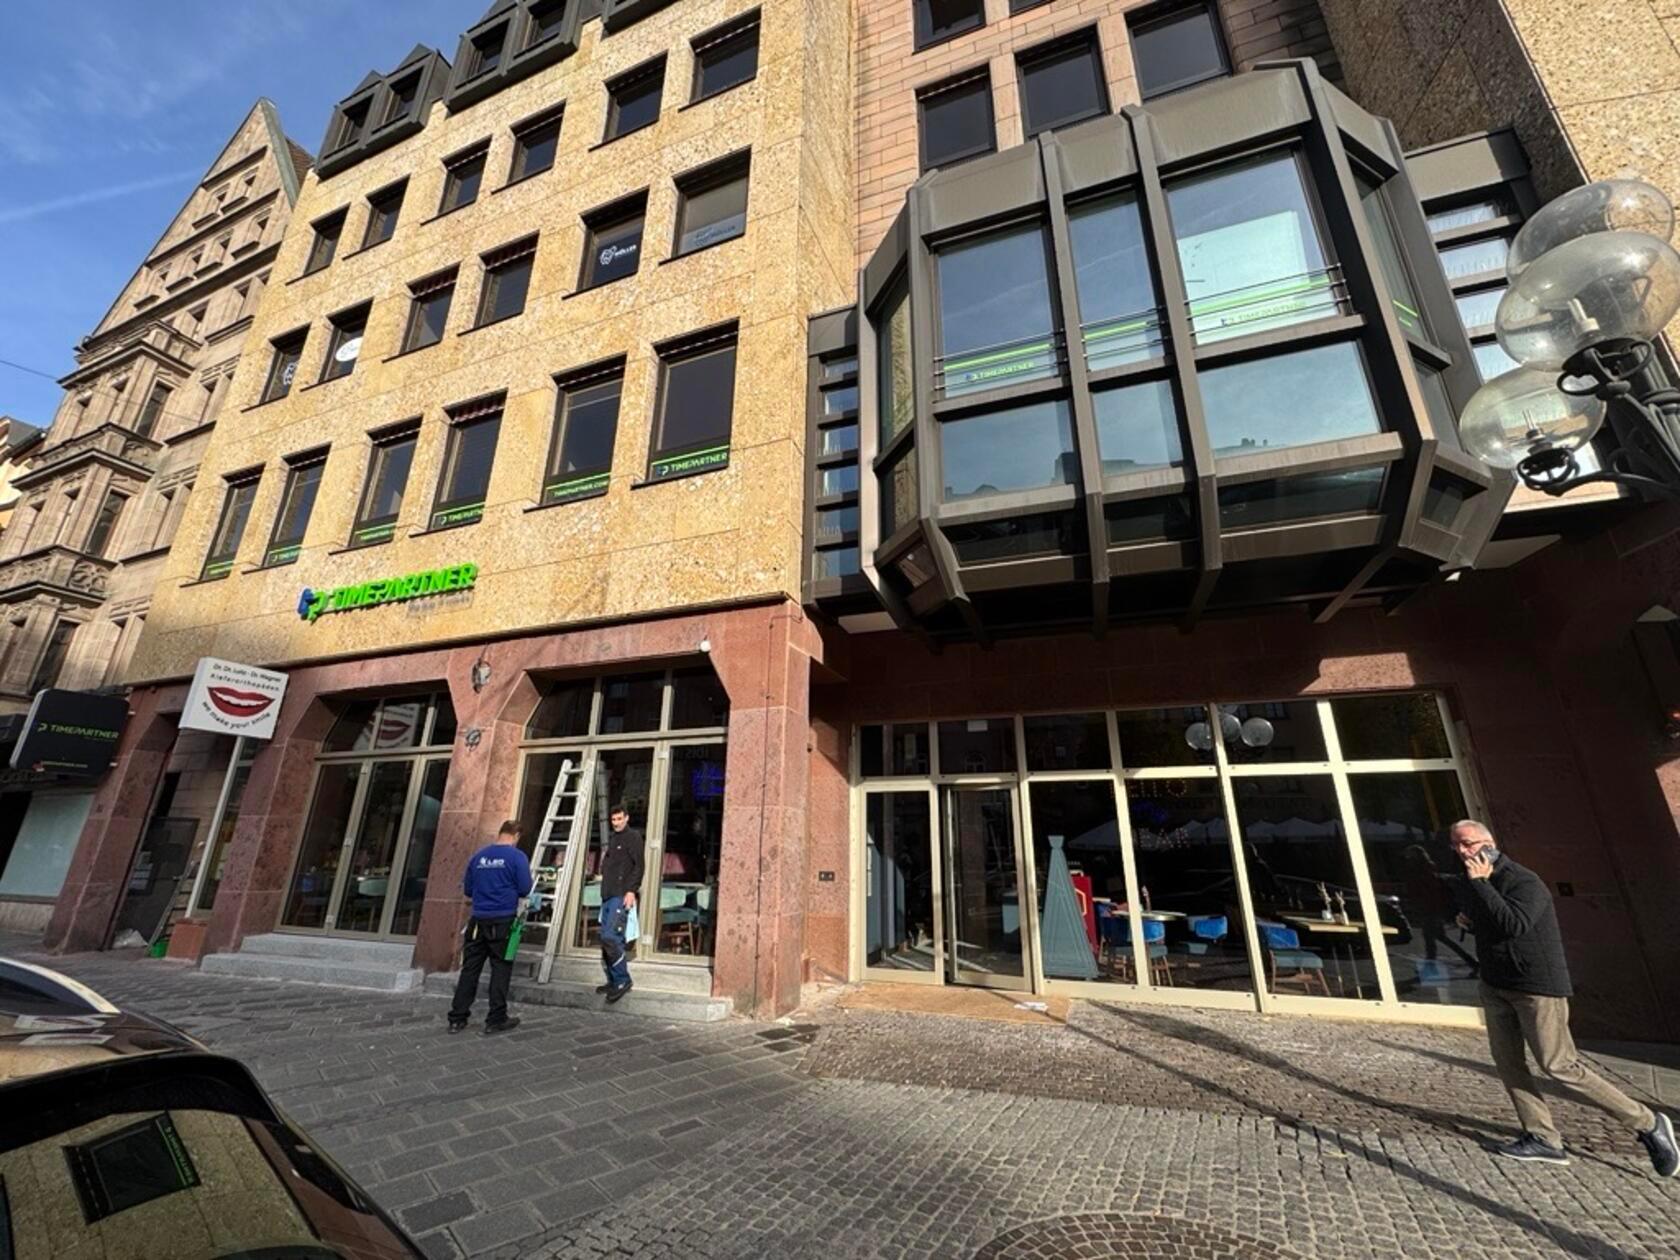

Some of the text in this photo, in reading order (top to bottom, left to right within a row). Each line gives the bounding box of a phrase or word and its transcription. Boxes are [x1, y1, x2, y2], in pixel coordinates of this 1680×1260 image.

[671, 452, 728, 472] TIMEPARTNER
[329, 561, 478, 609] TIMEPARTNER
[209, 712, 230, 726] make
[50, 724, 119, 739] TIMEPARTNER
